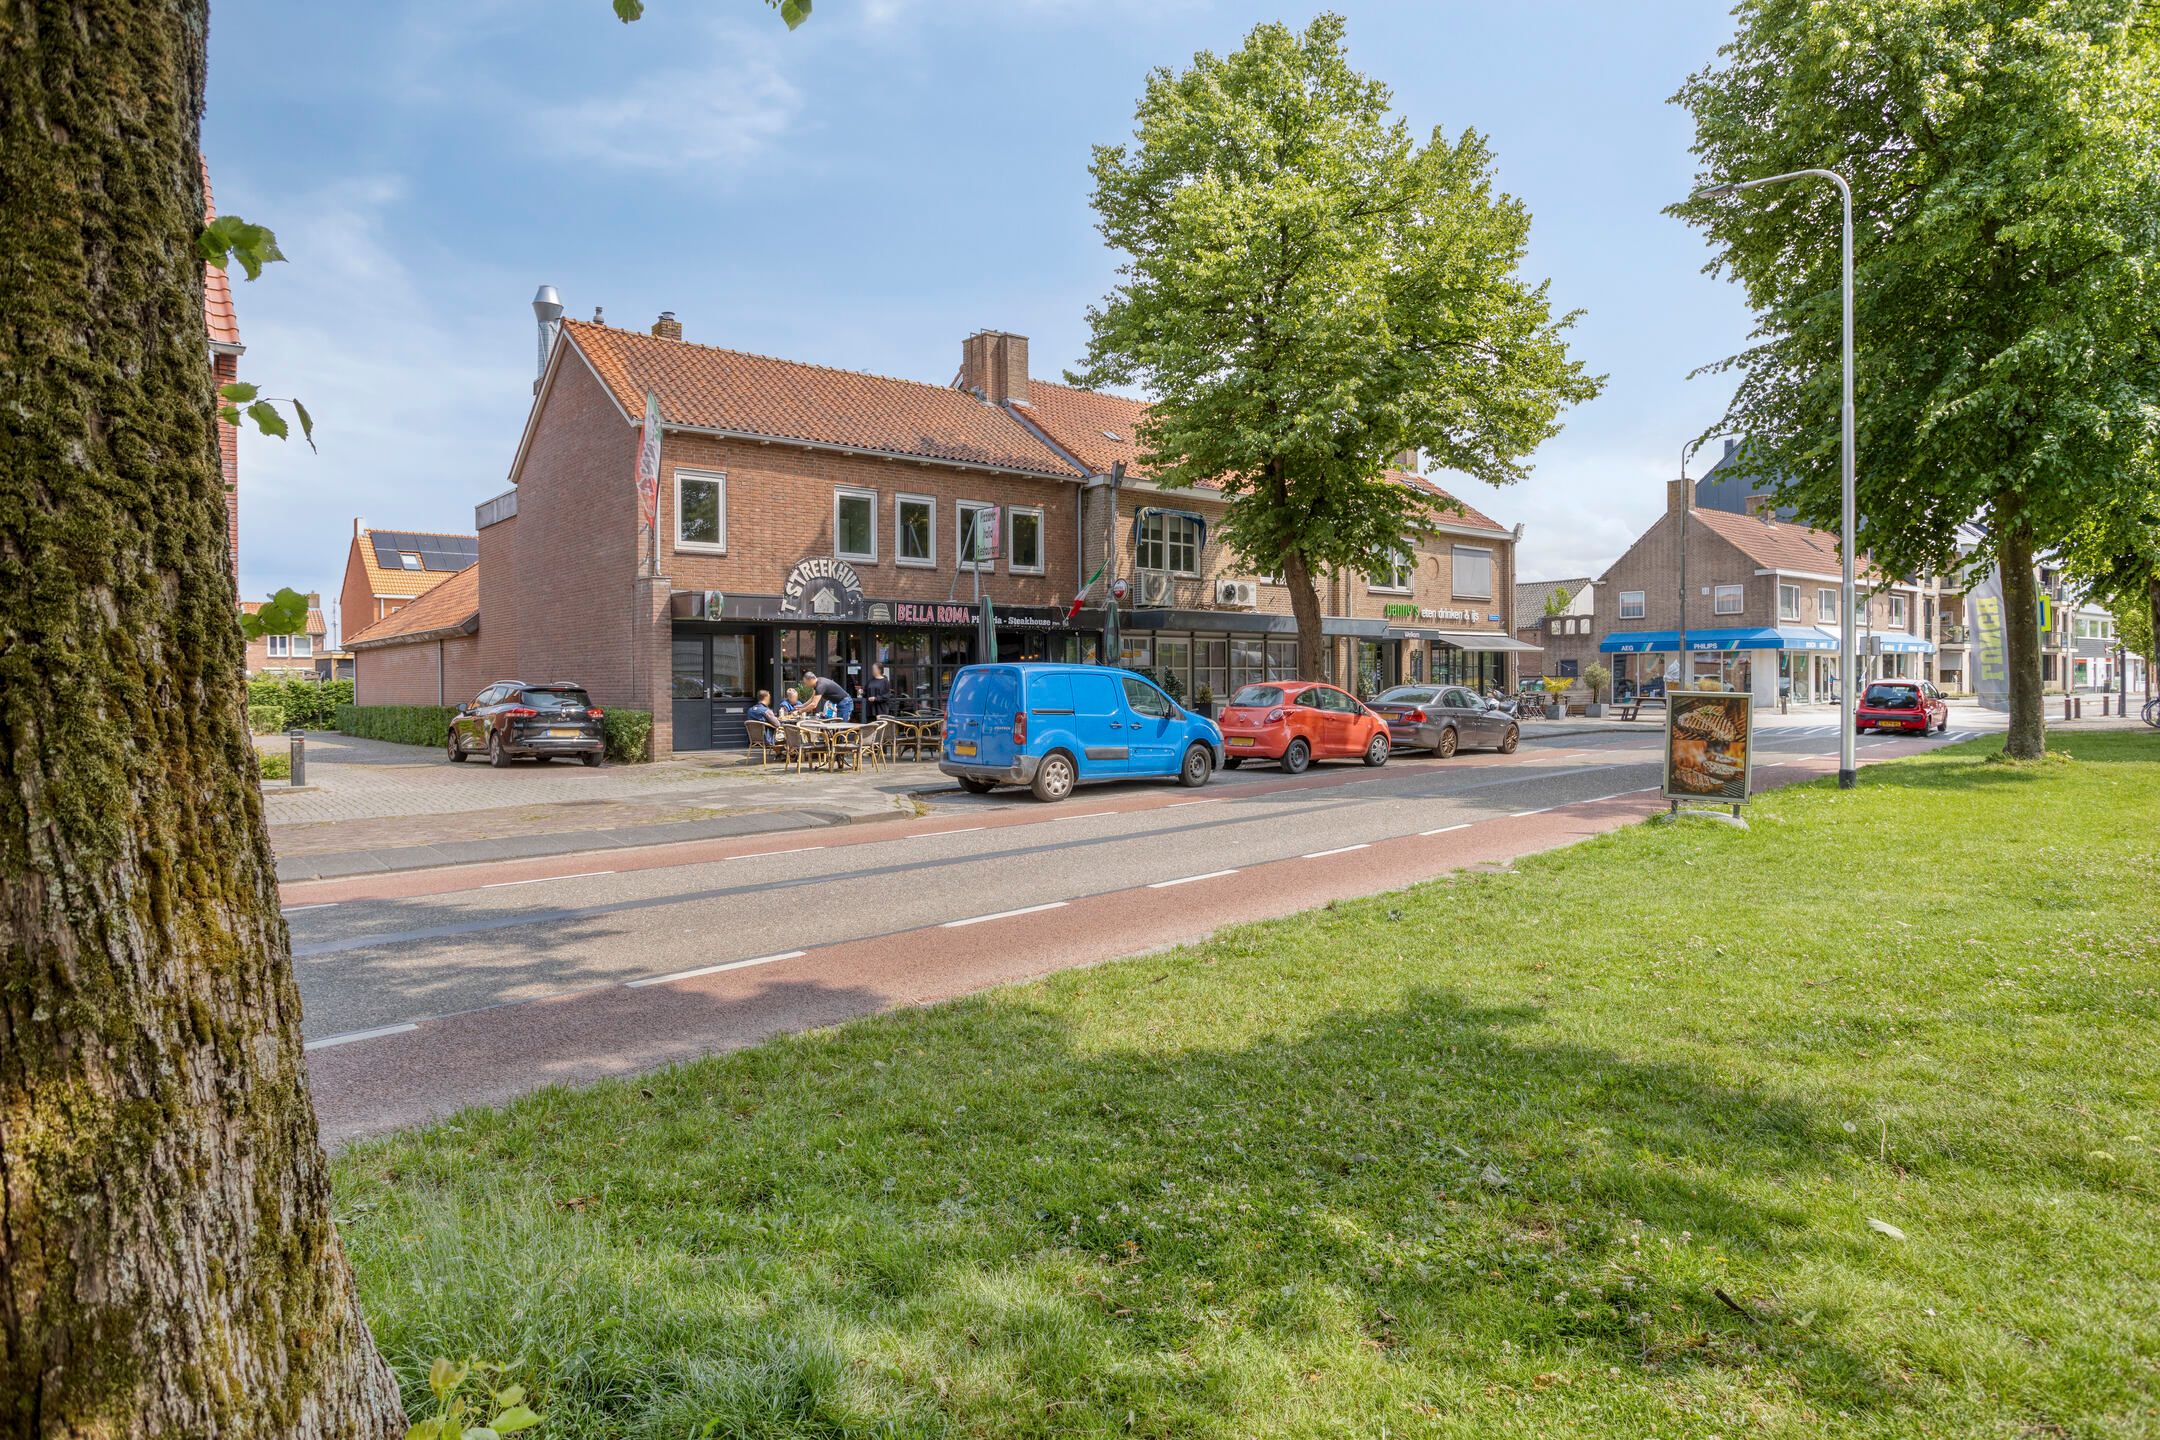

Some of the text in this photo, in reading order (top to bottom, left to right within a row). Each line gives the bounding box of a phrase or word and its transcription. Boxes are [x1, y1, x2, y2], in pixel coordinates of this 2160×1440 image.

[897, 604, 970, 624] BELLA ROMA
[971, 615, 1002, 625] Piria
[1008, 616, 1051, 626] Steakhouse
[1693, 642, 1718, 650] PHILIPS
